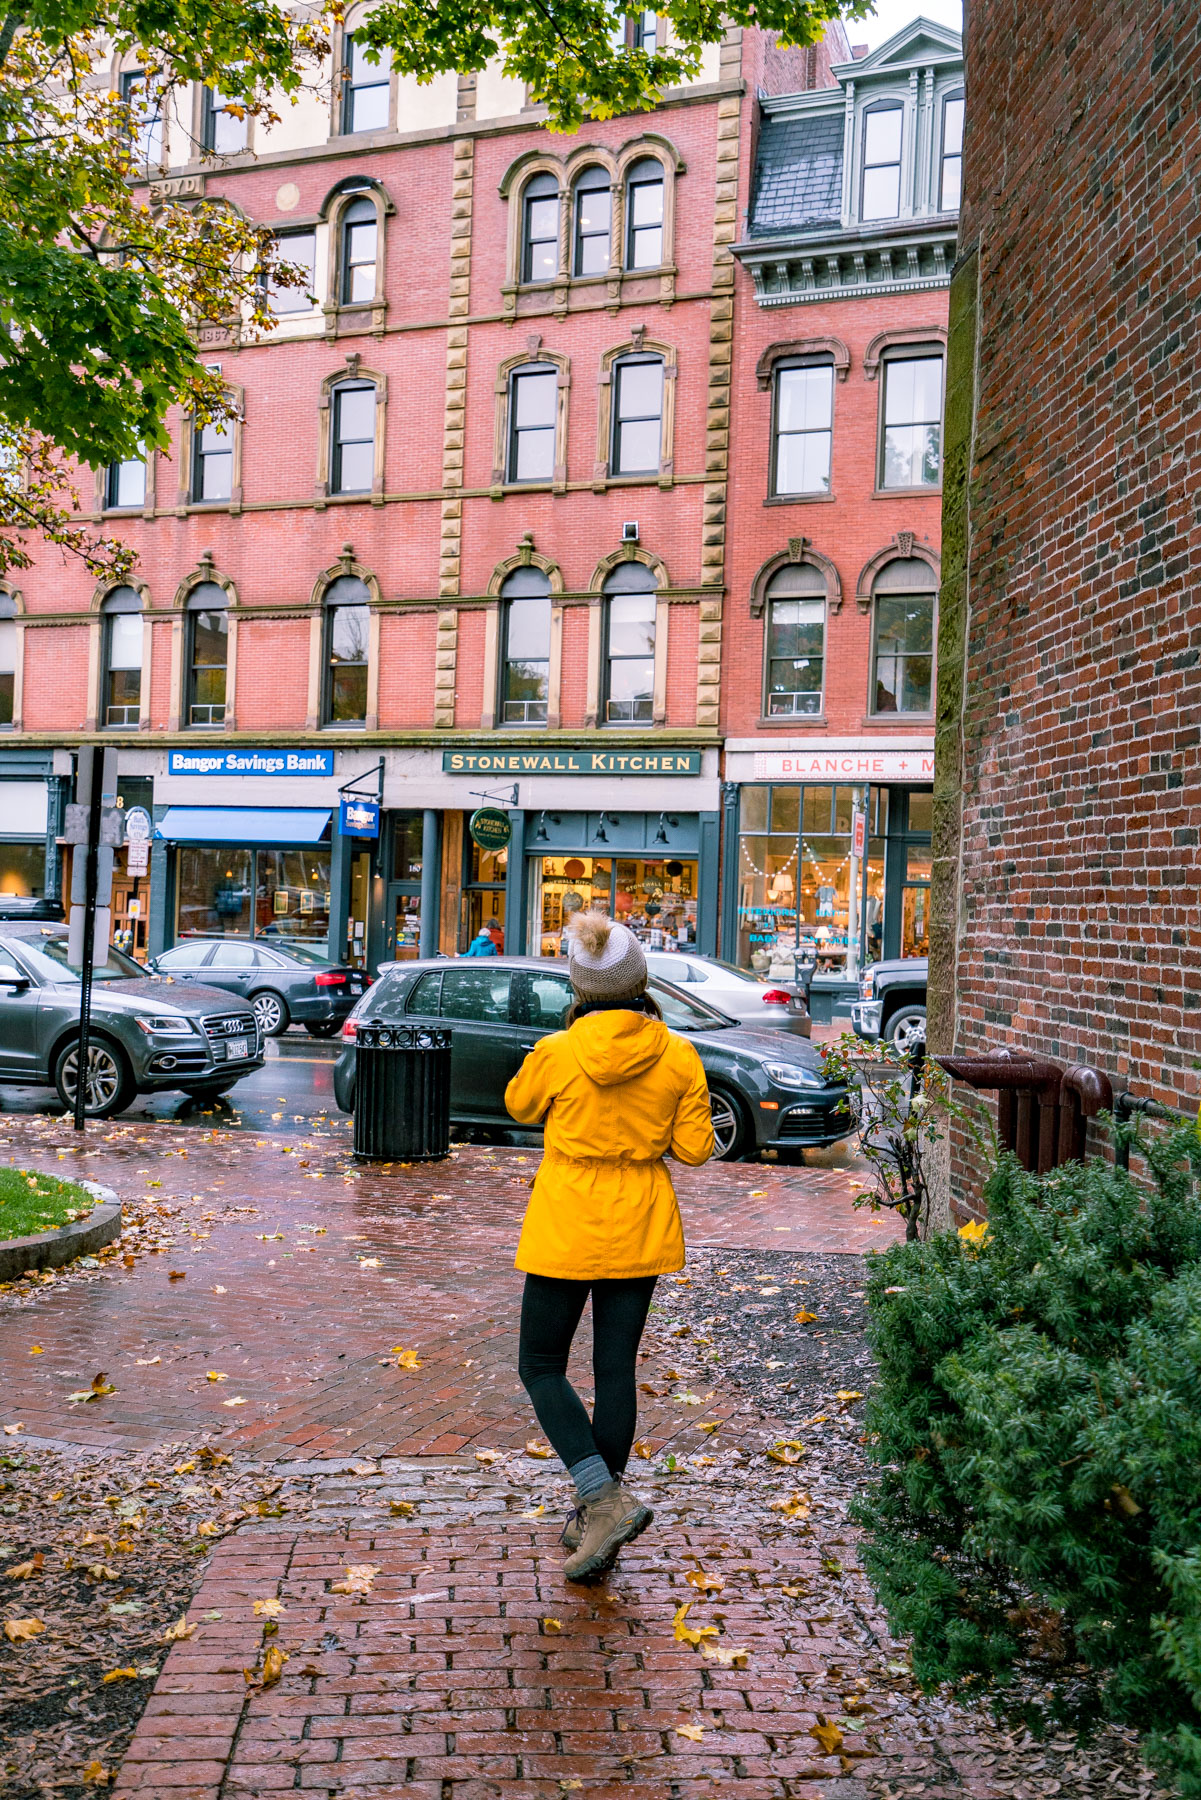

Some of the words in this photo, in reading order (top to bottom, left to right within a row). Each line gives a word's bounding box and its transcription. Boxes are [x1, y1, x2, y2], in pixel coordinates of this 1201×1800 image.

[171, 753, 225, 773] Bangor
[225, 753, 285, 773] Savings
[286, 754, 327, 771] Bank
[450, 754, 580, 770] STONEWALL
[591, 753, 691, 771] KITCHEN
[782, 758, 885, 773] BLANCHE
[664, 882, 691, 894] KITHEN
[737, 906, 796, 917] INTERIORS
[749, 933, 778, 943] BABY
[802, 935, 859, 945] ANTQUES
